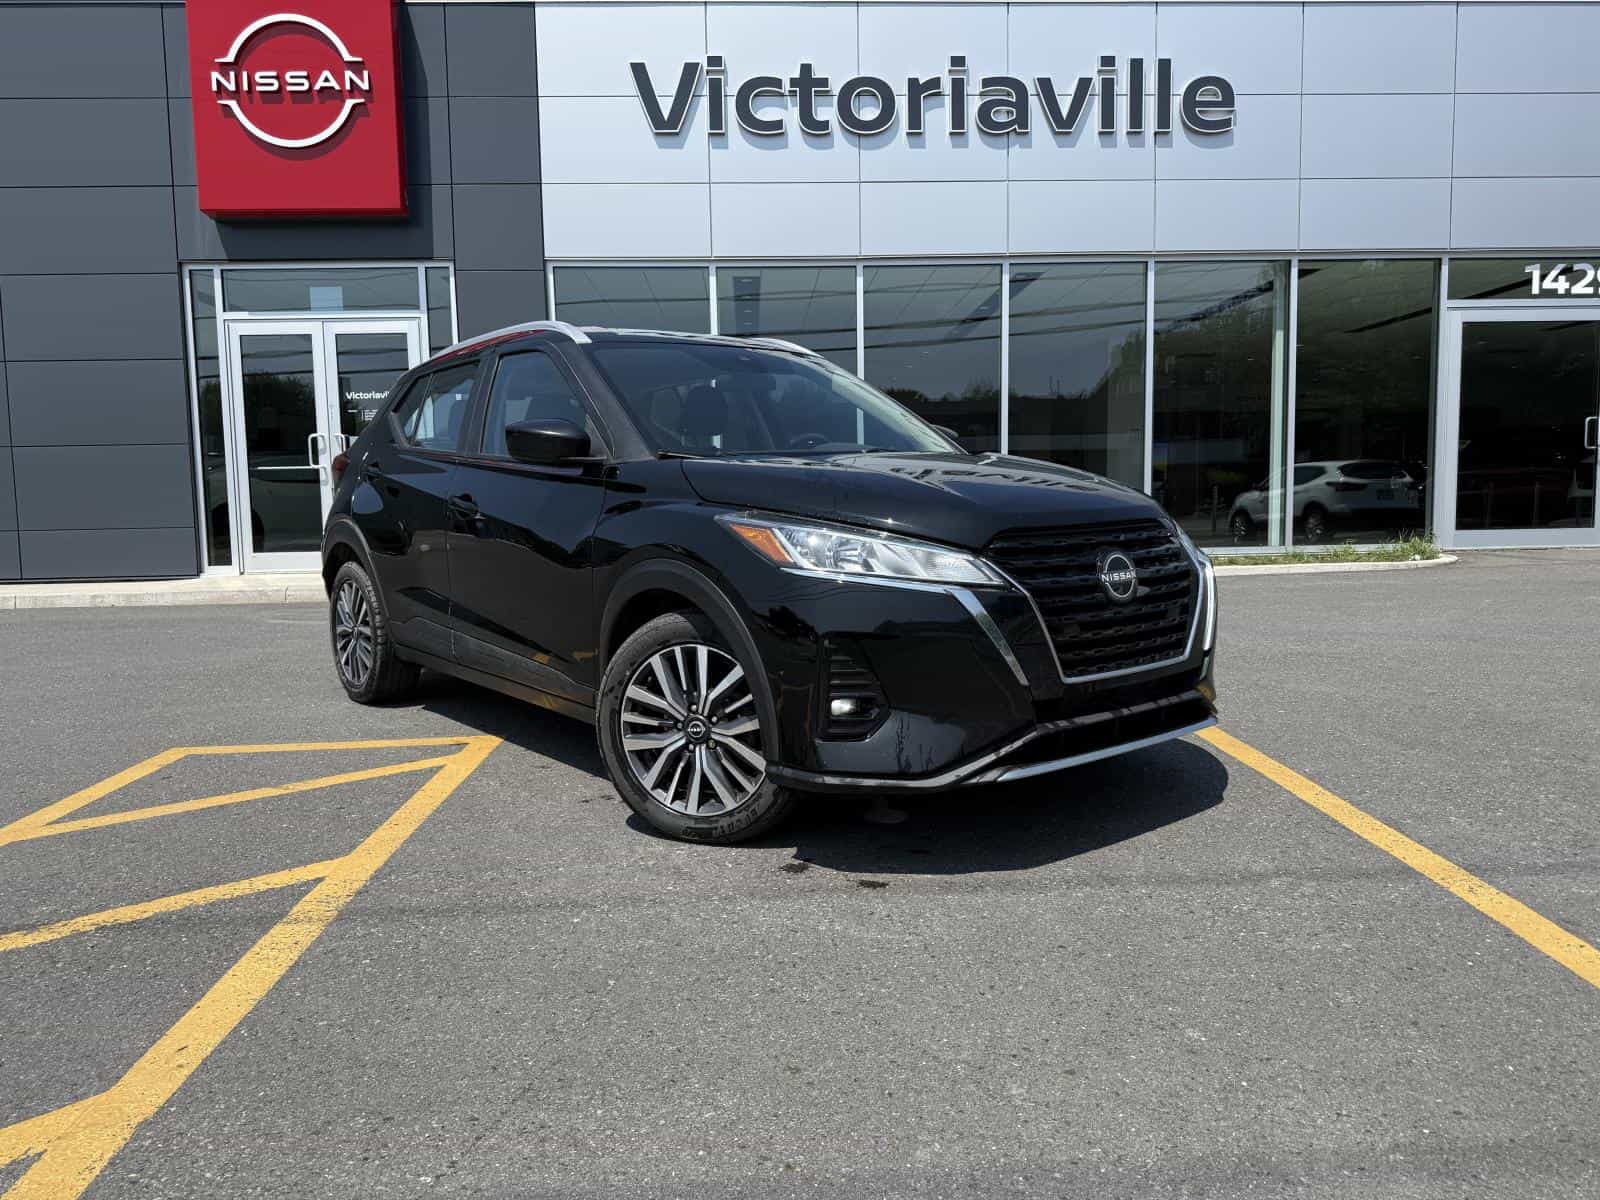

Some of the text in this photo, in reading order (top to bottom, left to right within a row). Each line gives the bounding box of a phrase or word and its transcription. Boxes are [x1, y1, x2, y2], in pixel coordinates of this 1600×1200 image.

[210, 70, 370, 92] NISSAN
[628, 55, 1236, 135] Victoriaville
[1524, 263, 1600, 295] 142
[345, 391, 390, 400] Victoriavi
[1101, 571, 1136, 582] NISSAN
